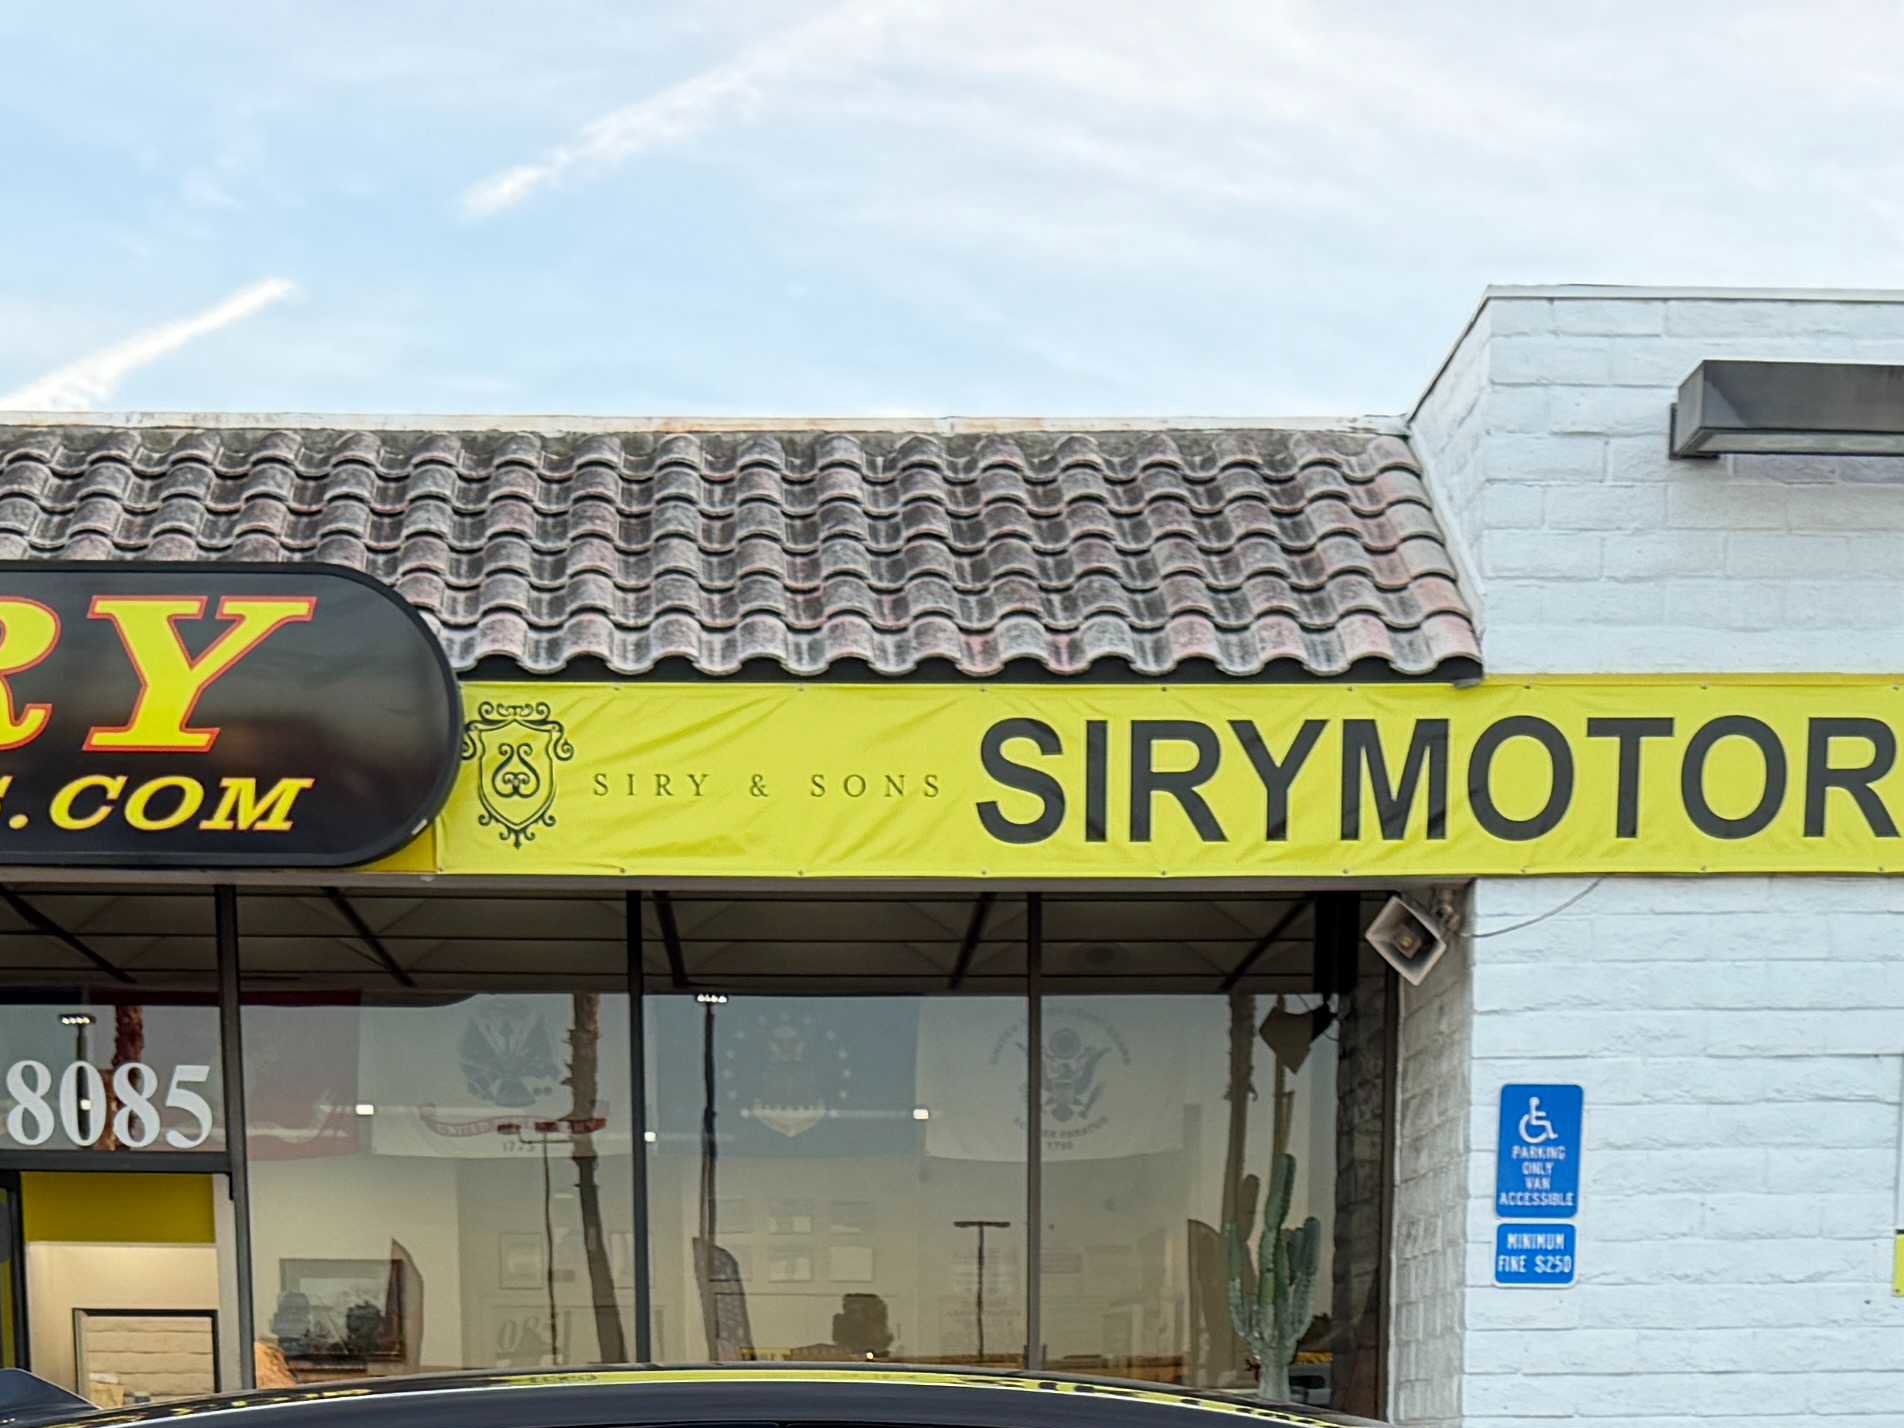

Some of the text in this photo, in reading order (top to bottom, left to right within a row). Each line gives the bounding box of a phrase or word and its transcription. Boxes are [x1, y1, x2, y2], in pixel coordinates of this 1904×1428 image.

[592, 772, 942, 799] SIRY & SONS
[5, 1059, 214, 1149] 8085
[1511, 1145, 1567, 1160] PARKING
[1521, 1161, 1554, 1176] ONLY
[1524, 1176, 1551, 1190] VAN
[1498, 1191, 1574, 1207] ACCESSIBLE
[1506, 1233, 1565, 1250] MINIMUM
[1497, 1254, 1572, 1274] FINE $250
